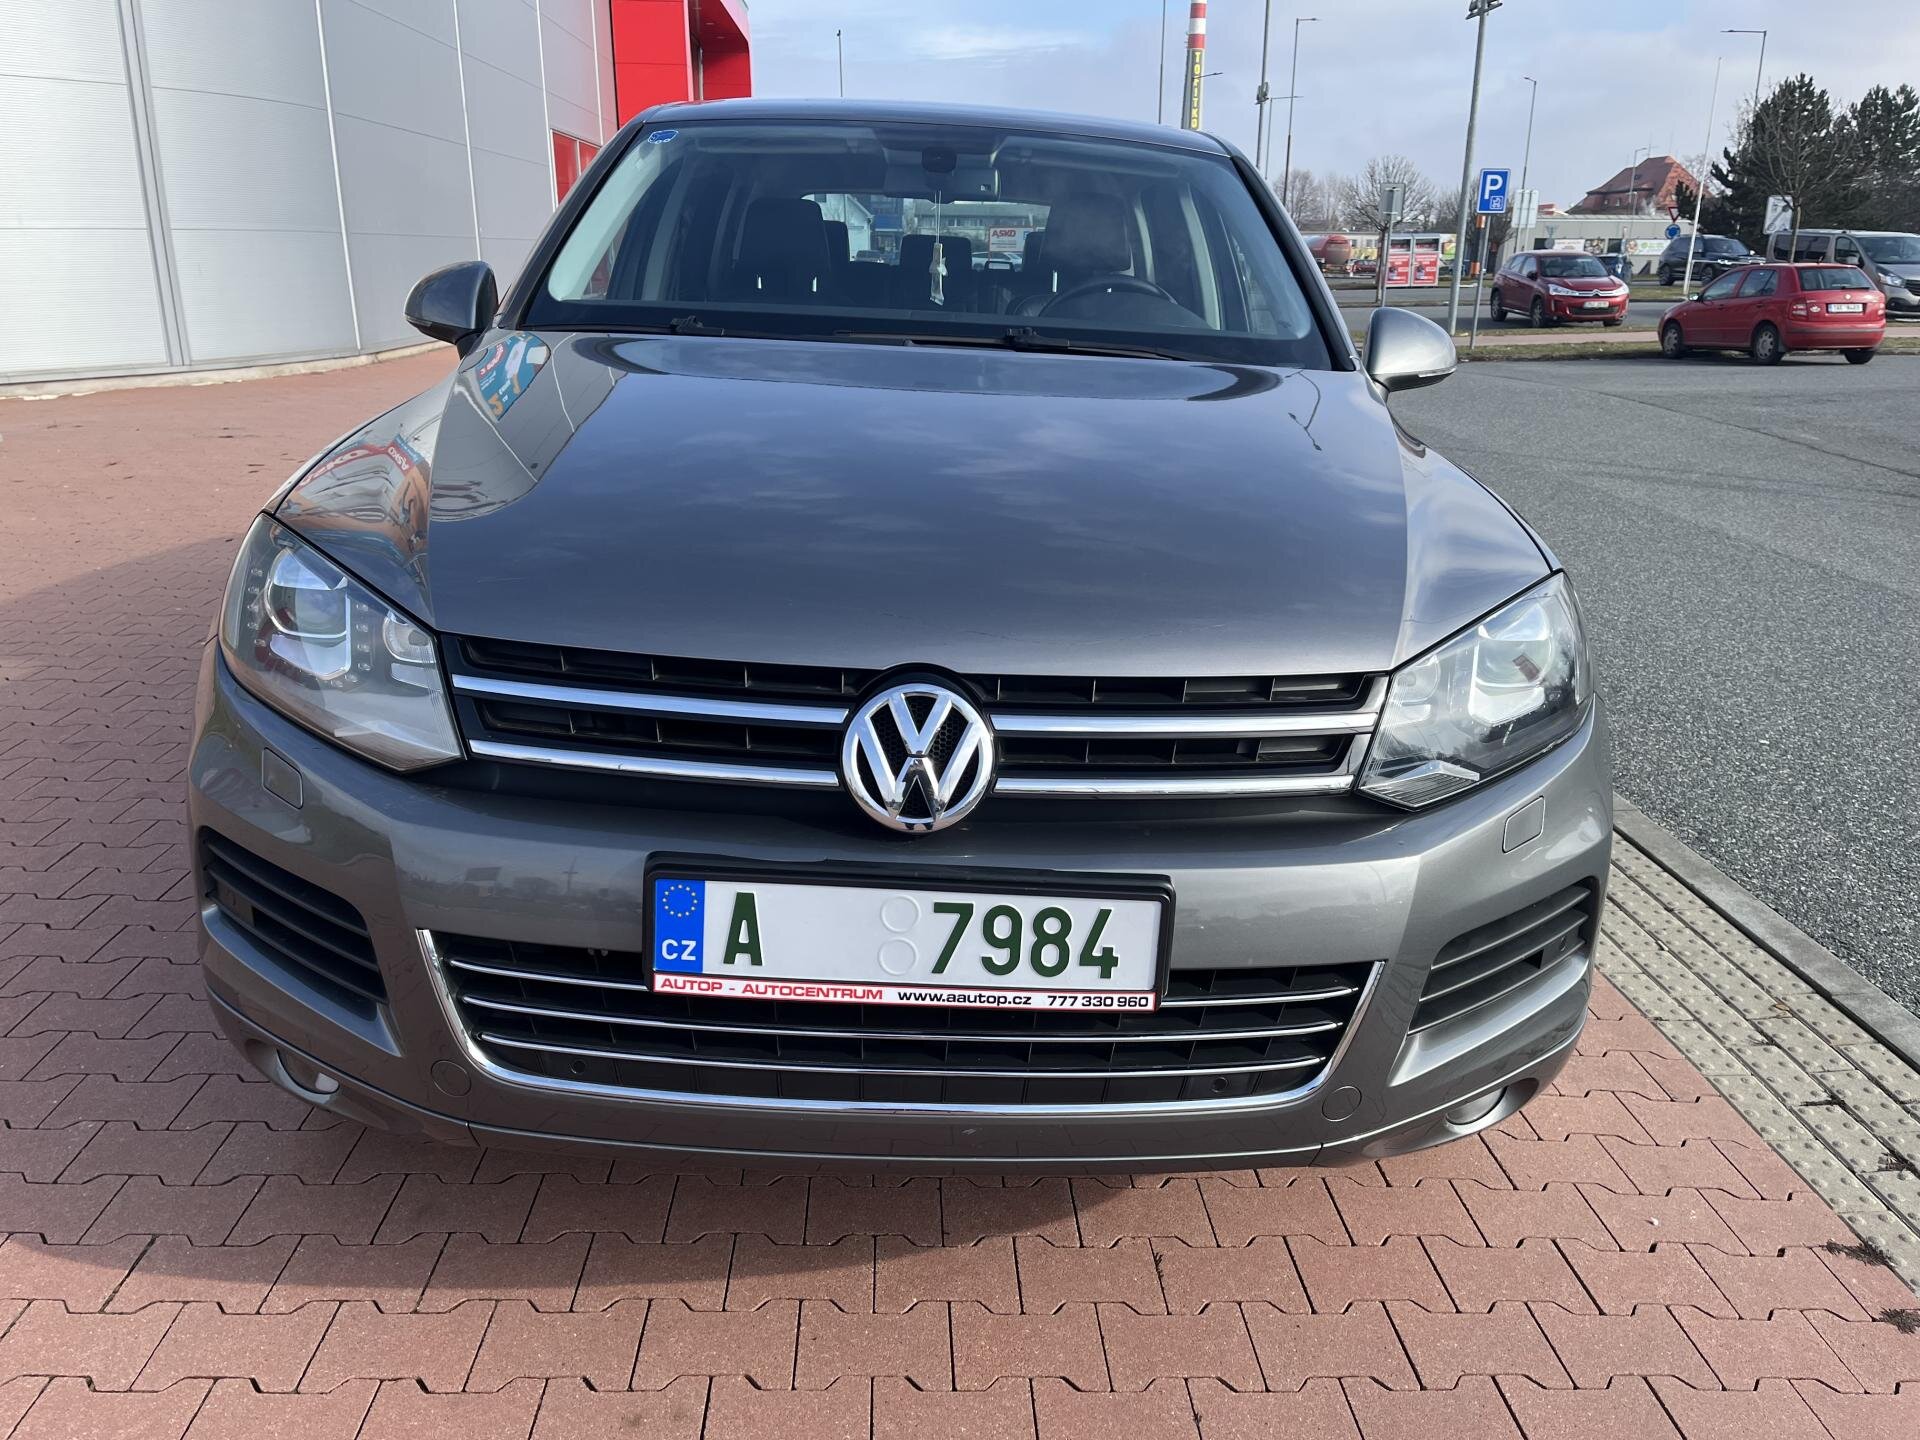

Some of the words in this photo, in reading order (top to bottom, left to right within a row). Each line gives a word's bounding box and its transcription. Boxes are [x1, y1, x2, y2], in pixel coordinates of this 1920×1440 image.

[1484, 175, 1504, 200] P
[723, 892, 763, 966] A
[931, 902, 1119, 979] 7984
[661, 938, 697, 961] CZ
[661, 978, 723, 992] AUTOP
[742, 984, 883, 1000] AUTOCENTRUM
[897, 990, 1032, 1006] www.aautop.cz
[1047, 995, 1077, 1007] 777
[1081, 996, 1112, 1007] 330
[1117, 996, 1149, 1008] 960
